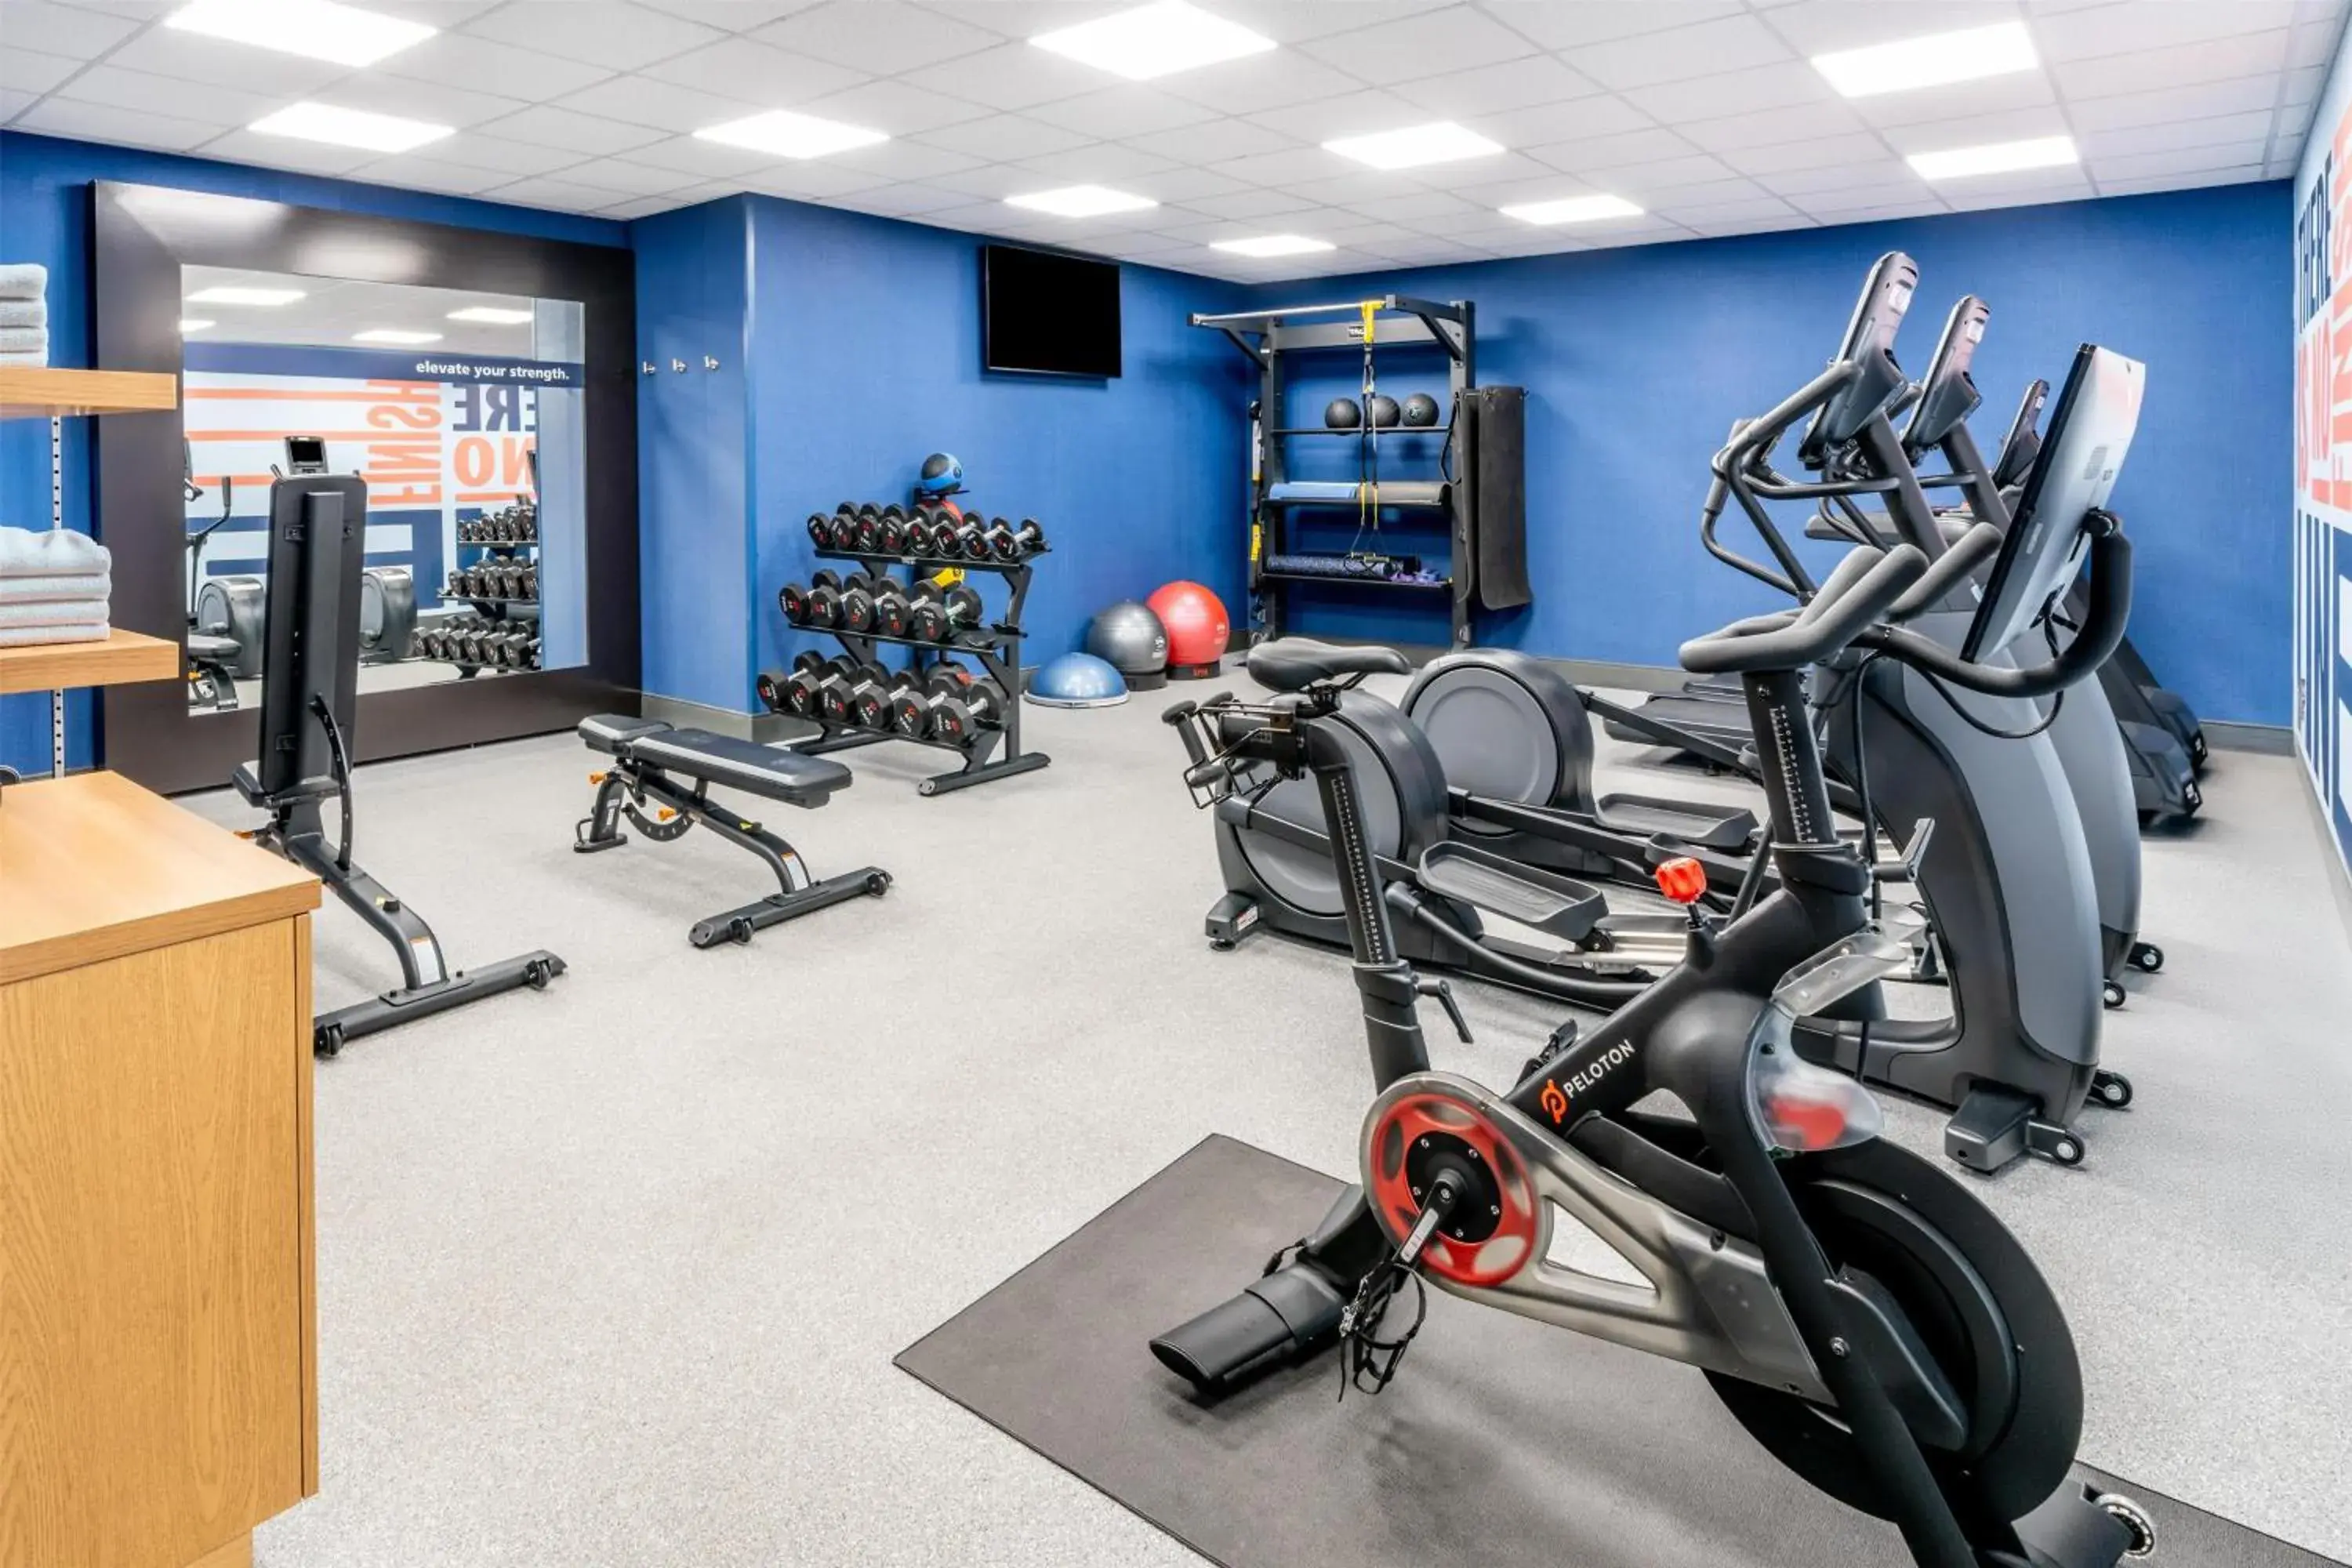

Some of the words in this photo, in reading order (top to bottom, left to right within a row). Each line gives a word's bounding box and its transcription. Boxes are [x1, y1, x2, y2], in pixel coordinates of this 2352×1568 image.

[2298, 148, 2332, 335] THERE
[415, 360, 470, 375] elevate
[474, 365, 506, 378] your
[510, 366, 570, 382] strength.
[2297, 343, 2309, 490] IS
[2311, 318, 2331, 460] NO
[1563, 1039, 1635, 1099] PELOTON
